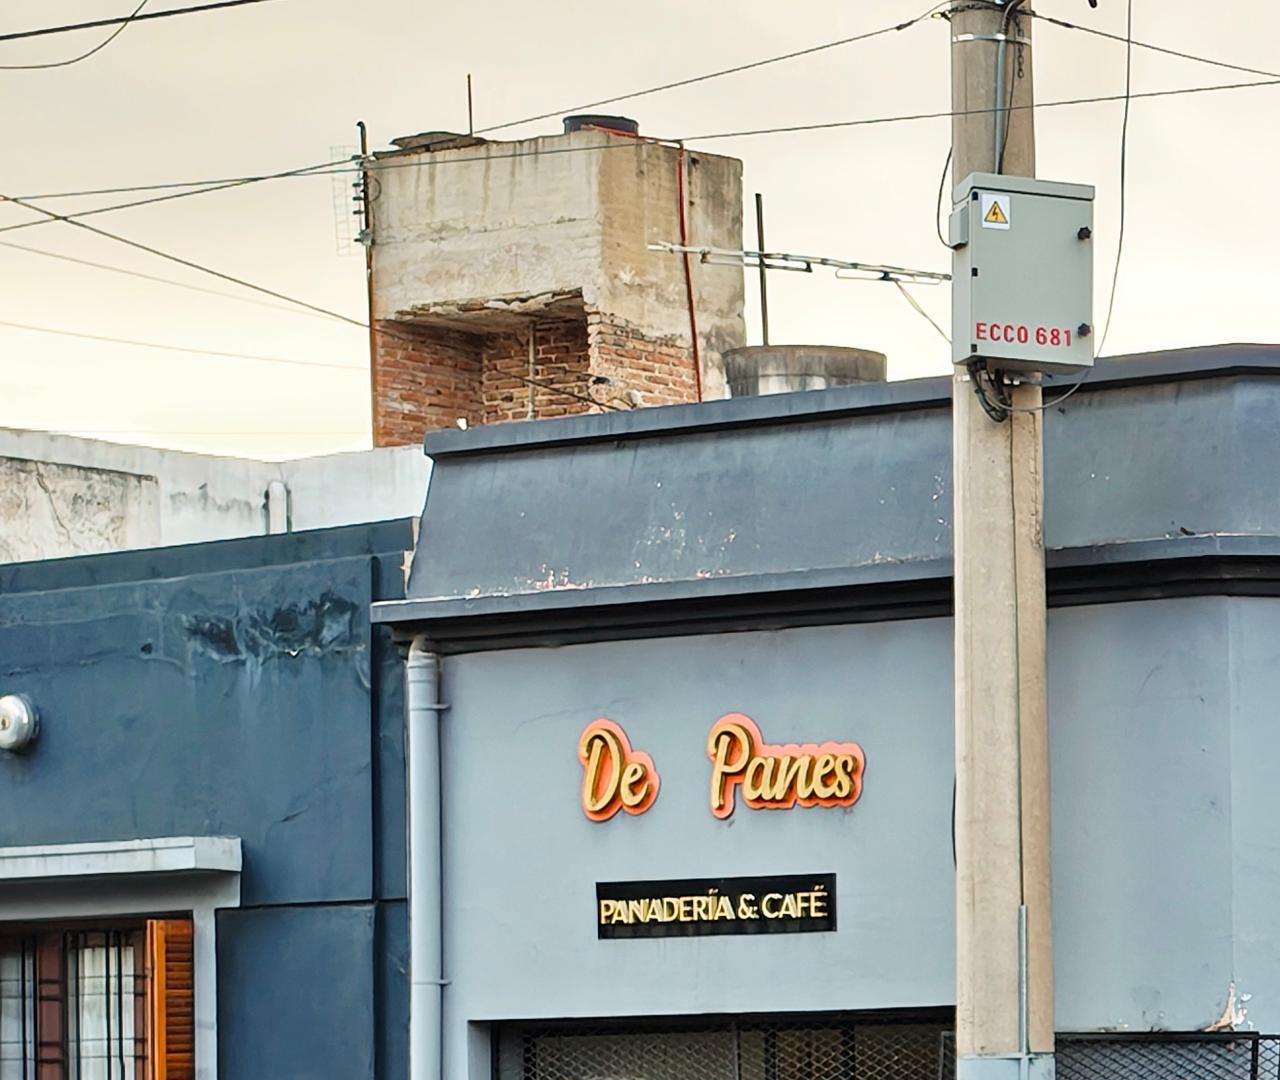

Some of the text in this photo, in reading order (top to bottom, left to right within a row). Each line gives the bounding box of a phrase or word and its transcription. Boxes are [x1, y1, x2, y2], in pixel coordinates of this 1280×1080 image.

[976, 322, 1071, 347] ECCO 681
[583, 722, 857, 812] De Panes
[600, 885, 828, 924] PANADERÍA & CAFÉ
